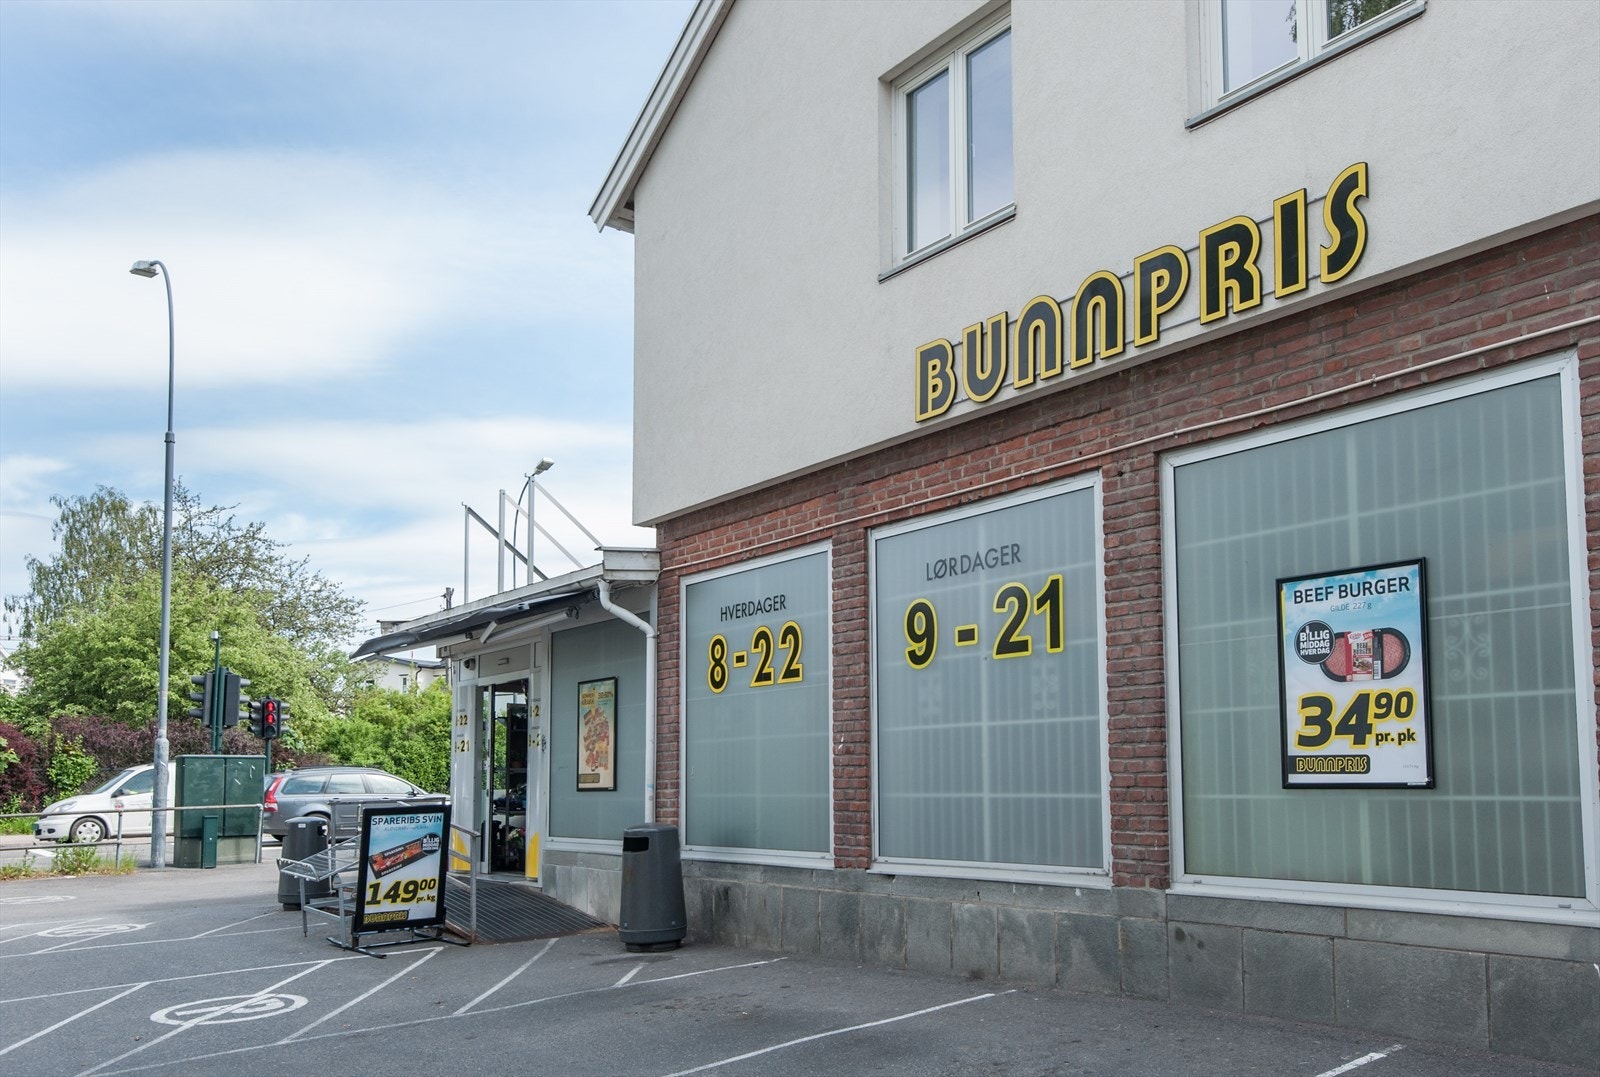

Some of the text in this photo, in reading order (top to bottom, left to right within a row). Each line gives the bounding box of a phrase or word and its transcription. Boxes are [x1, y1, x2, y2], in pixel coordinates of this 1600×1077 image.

[915, 161, 1369, 423] BUNNPRIS
[926, 543, 1022, 581] LØRDAGER
[1293, 576, 1410, 605] BEEF BURGER
[720, 594, 786, 622] HVERDAGER
[1330, 603, 1350, 612] GILDE
[1375, 728, 1417, 746] pr. pk
[1296, 756, 1367, 772] BUNNPRIS
[372, 815, 442, 825] SPARERIBS SVIN
